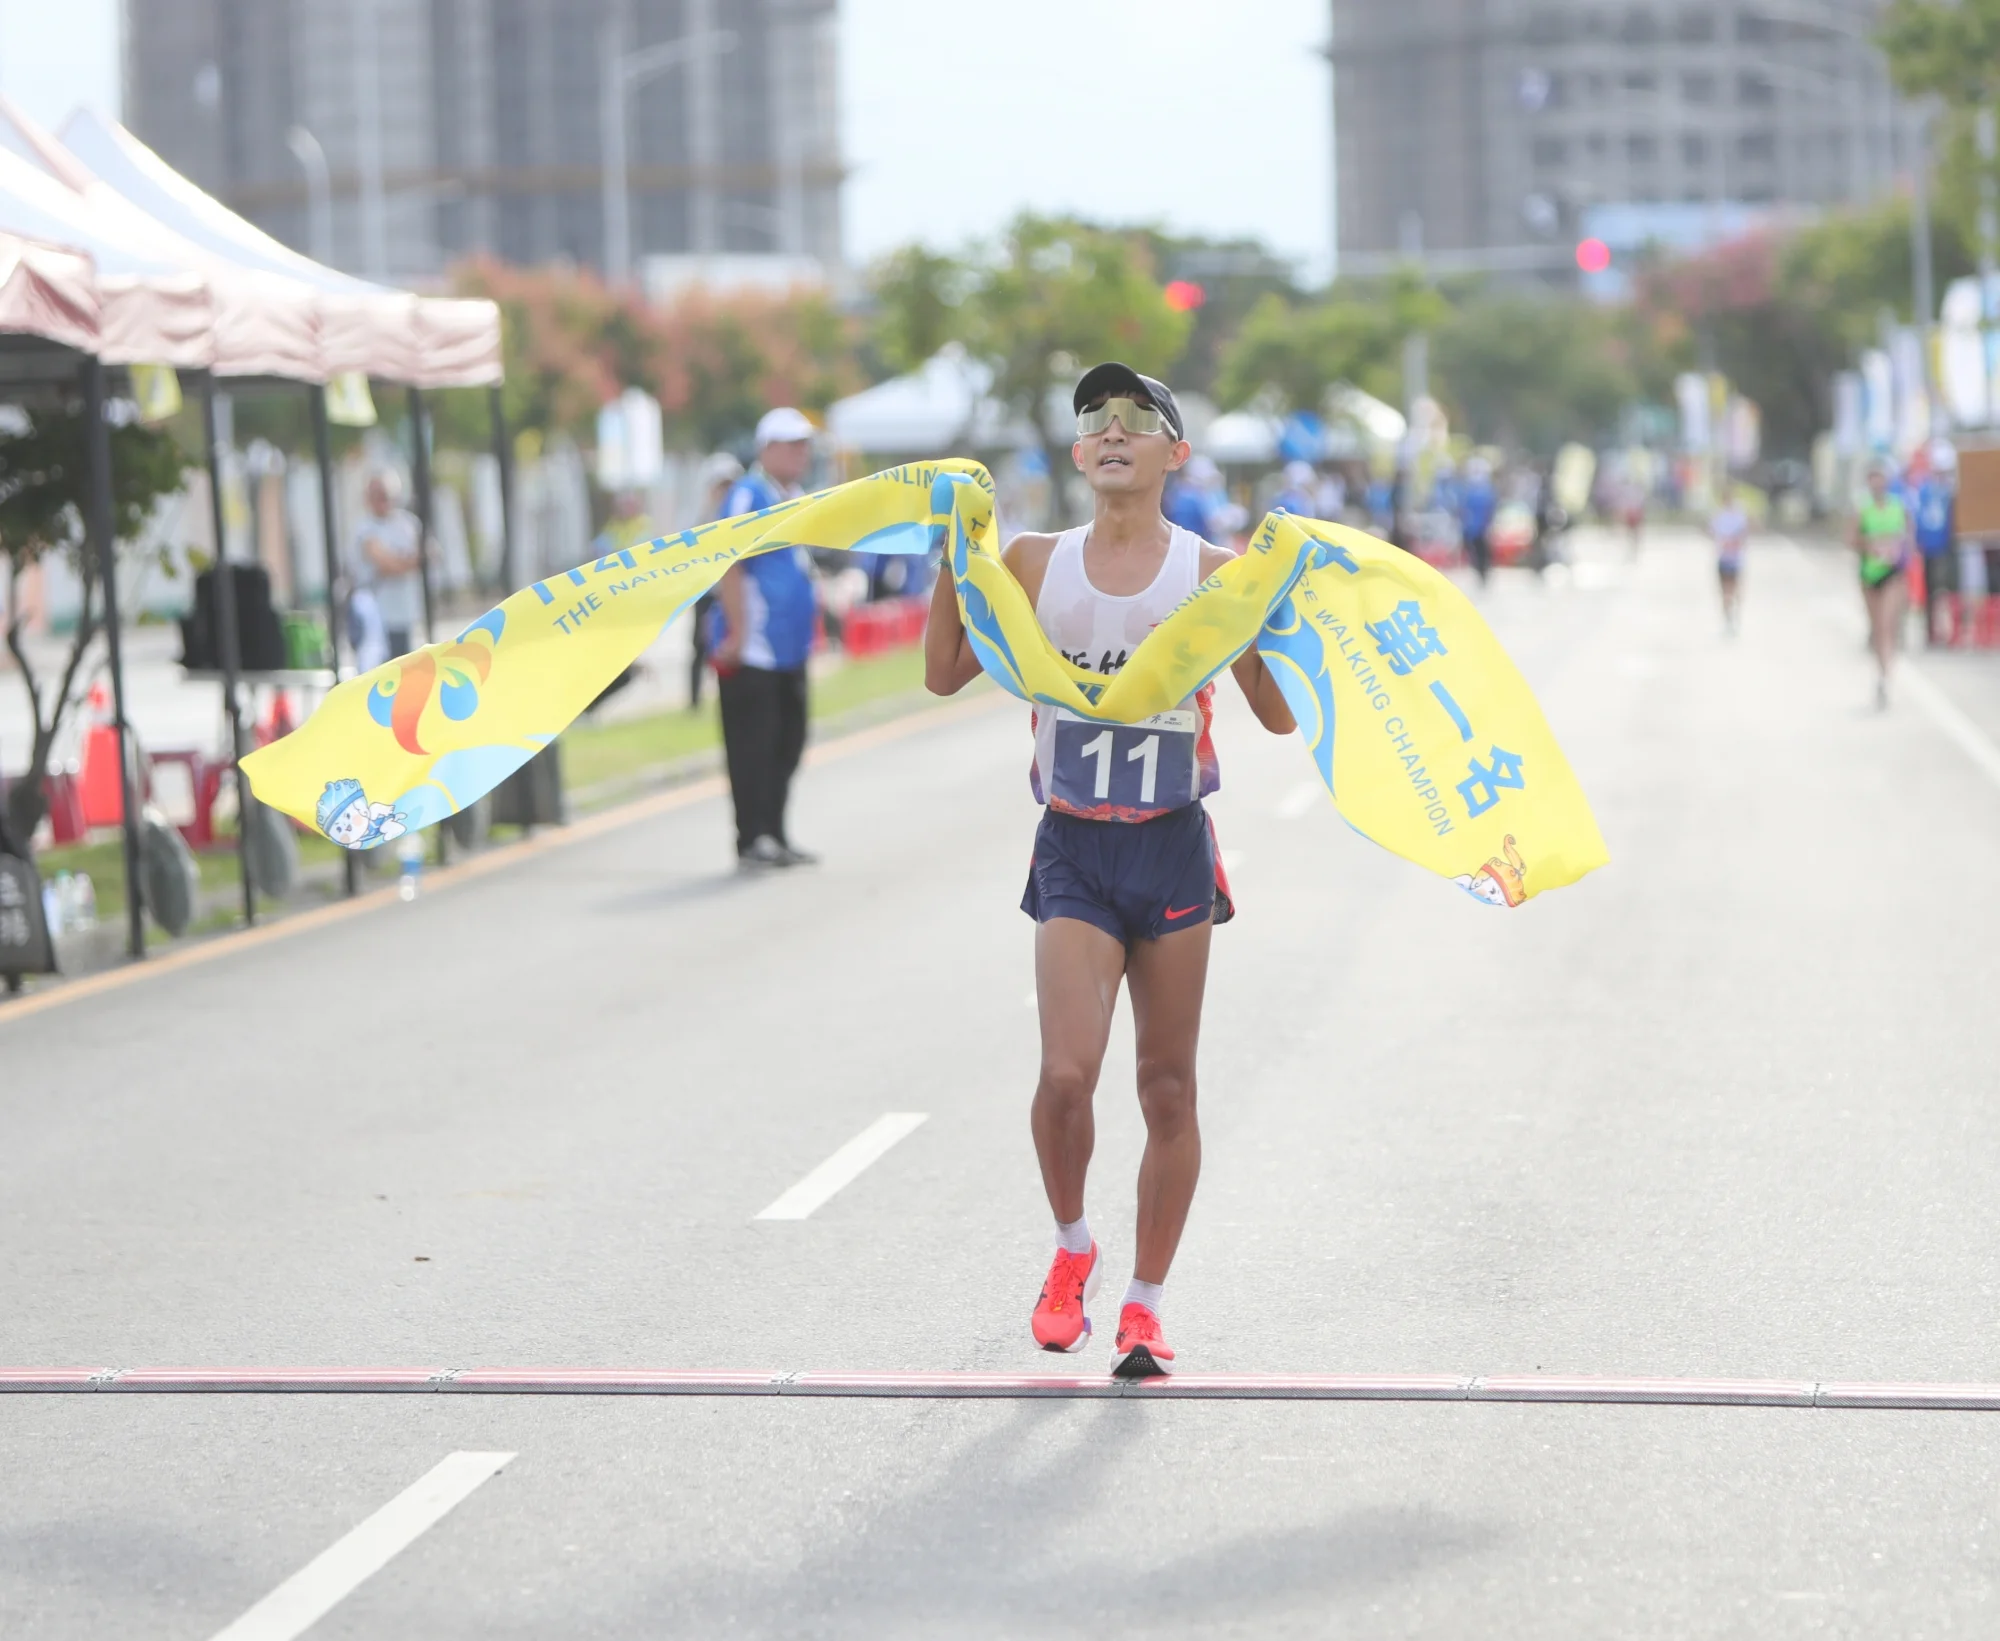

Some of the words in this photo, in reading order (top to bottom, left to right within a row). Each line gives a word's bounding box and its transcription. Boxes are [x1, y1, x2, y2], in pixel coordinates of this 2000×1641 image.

[552, 591, 604, 635] THE
[608, 547, 743, 596] NATIONAL
[1080, 730, 1160, 803] 11
[1315, 609, 1391, 711] WALKING
[1385, 716, 1455, 837] CHAMPION
[1364, 599, 1526, 819] 第一名
